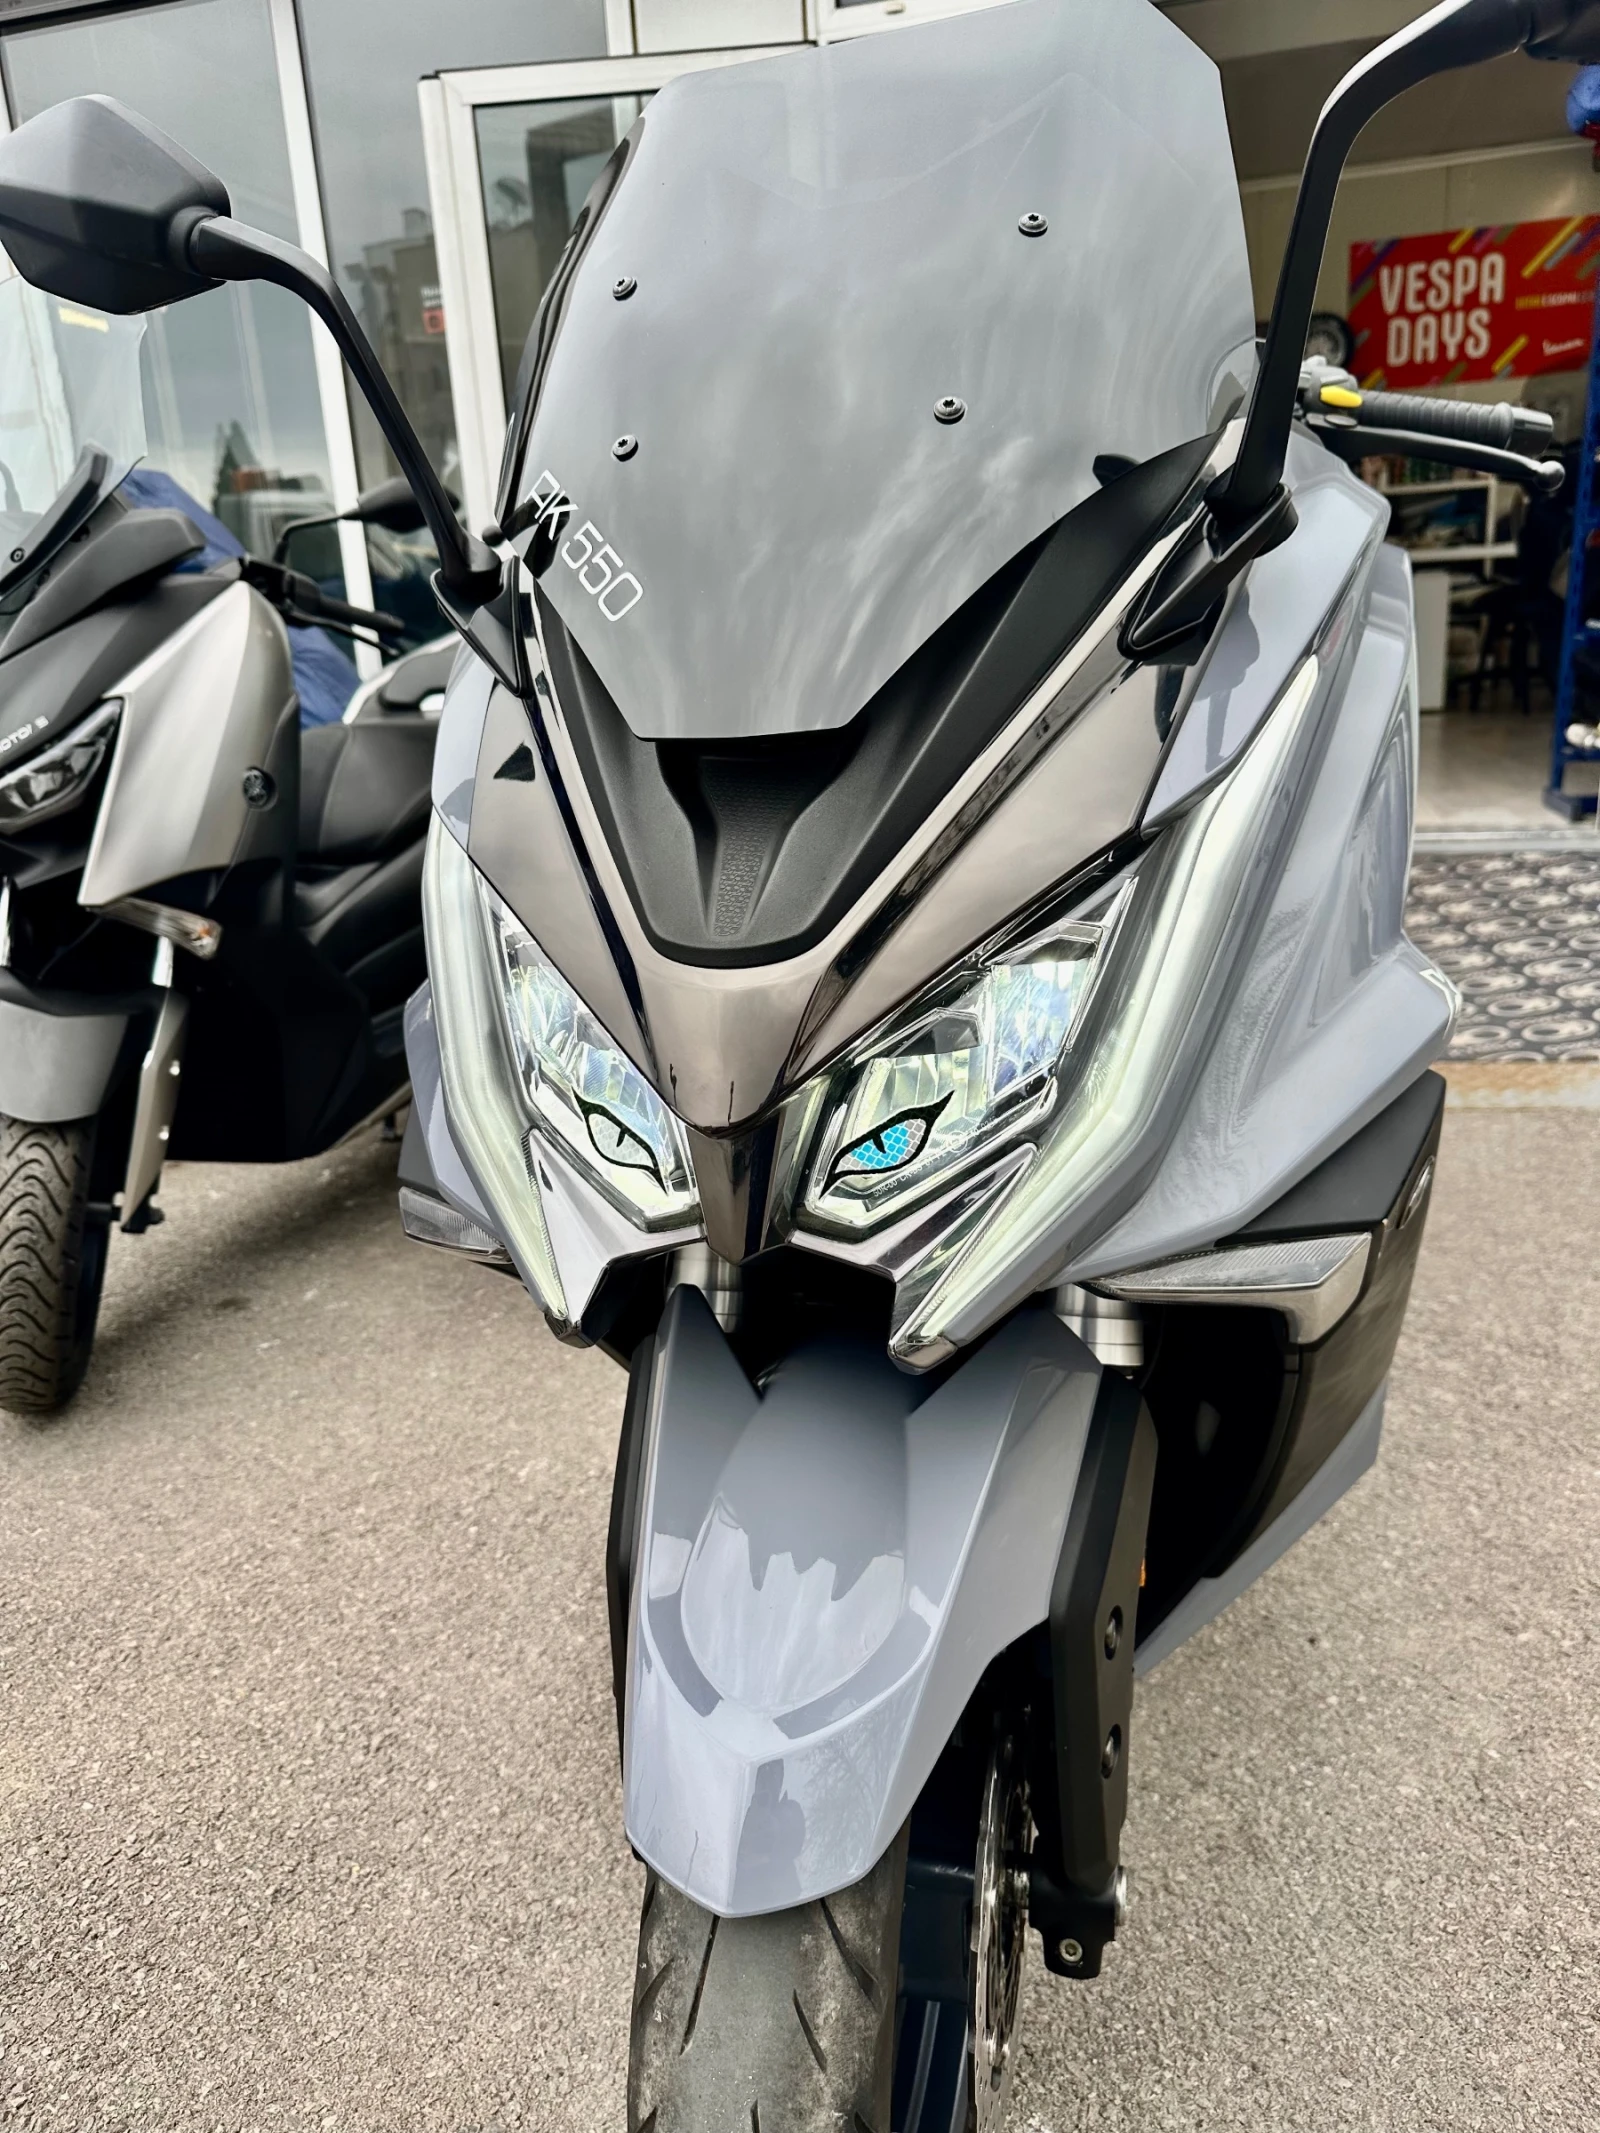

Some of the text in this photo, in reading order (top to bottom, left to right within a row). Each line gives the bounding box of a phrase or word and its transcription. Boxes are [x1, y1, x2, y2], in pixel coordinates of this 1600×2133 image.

[1379, 252, 1505, 315] VESPA
[1386, 307, 1490, 367] DAYS
[524, 469, 643, 621] AK 550
